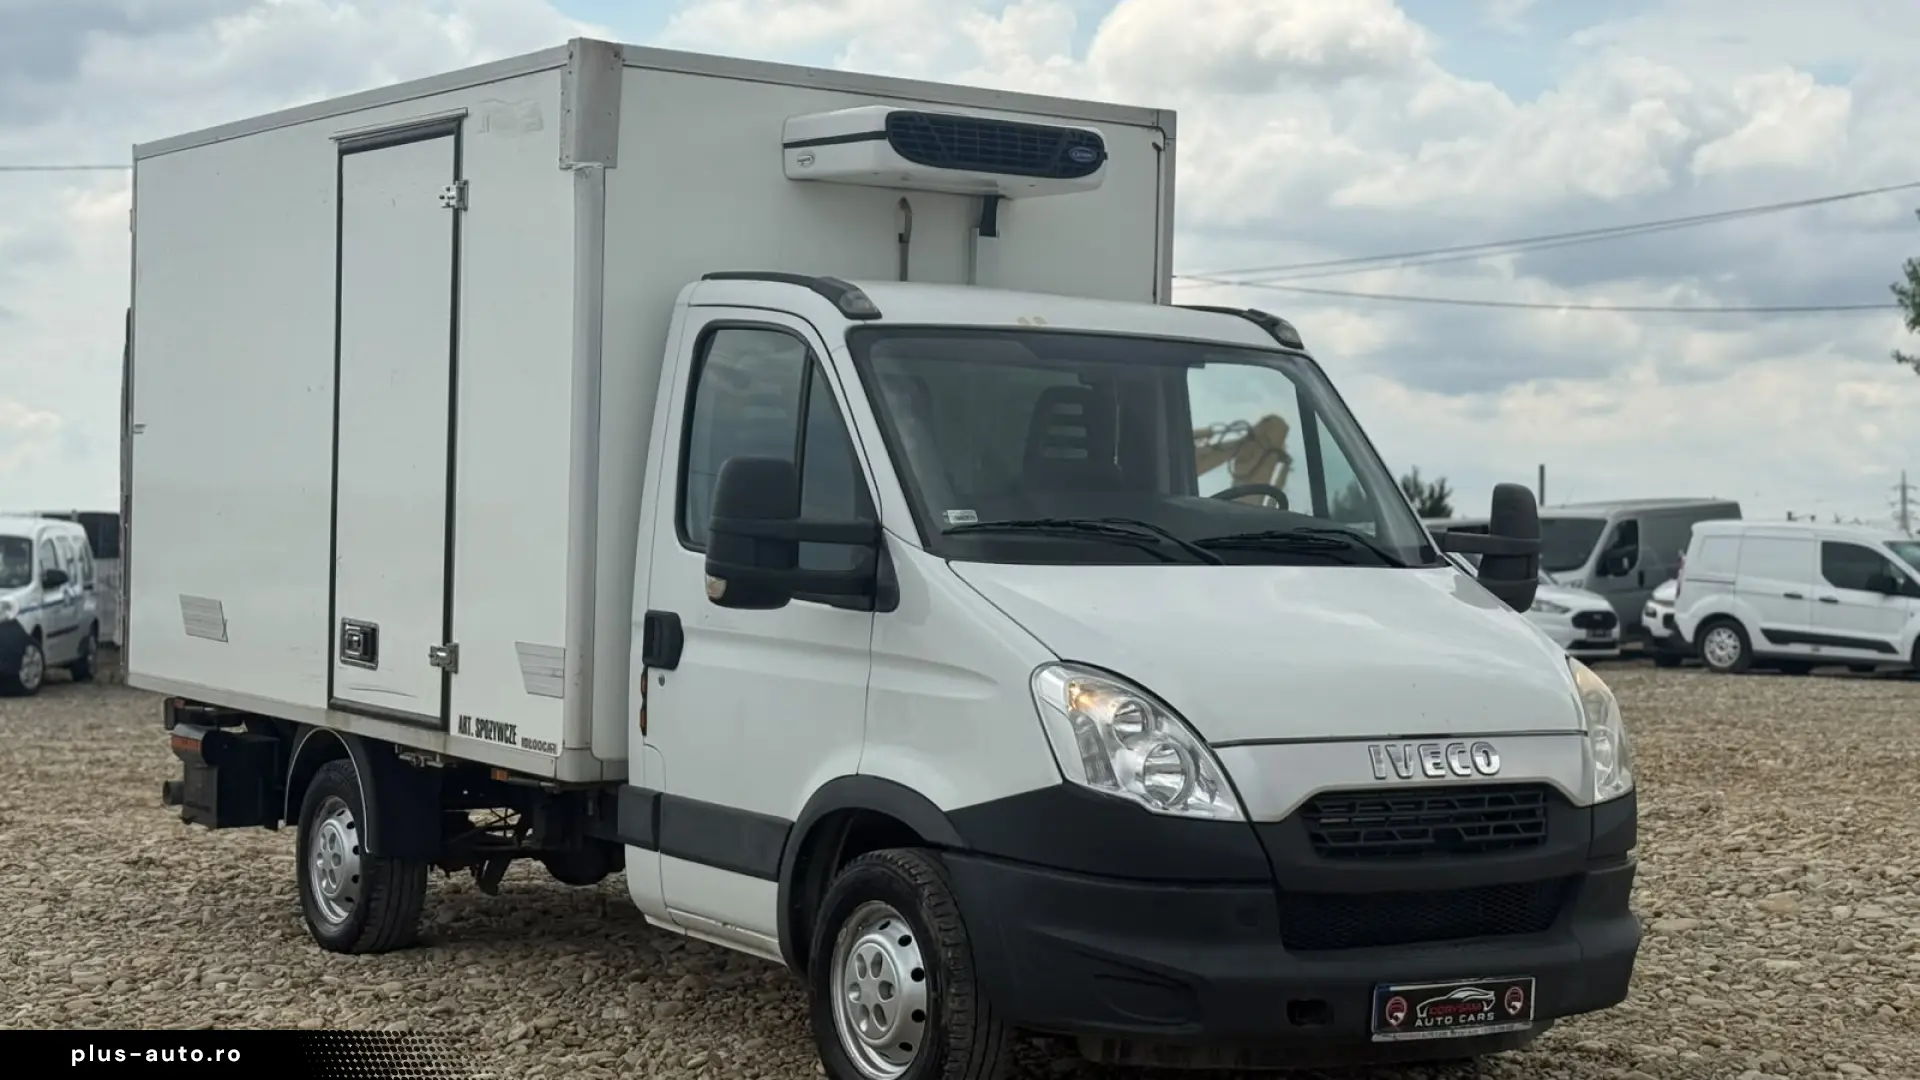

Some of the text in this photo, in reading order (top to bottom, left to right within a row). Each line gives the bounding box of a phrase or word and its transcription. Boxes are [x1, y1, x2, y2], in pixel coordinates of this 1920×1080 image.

[458, 714, 474, 737] ART.
[1368, 741, 1501, 780] IVECO
[1415, 1012, 1495, 1028] AUTO CARS
